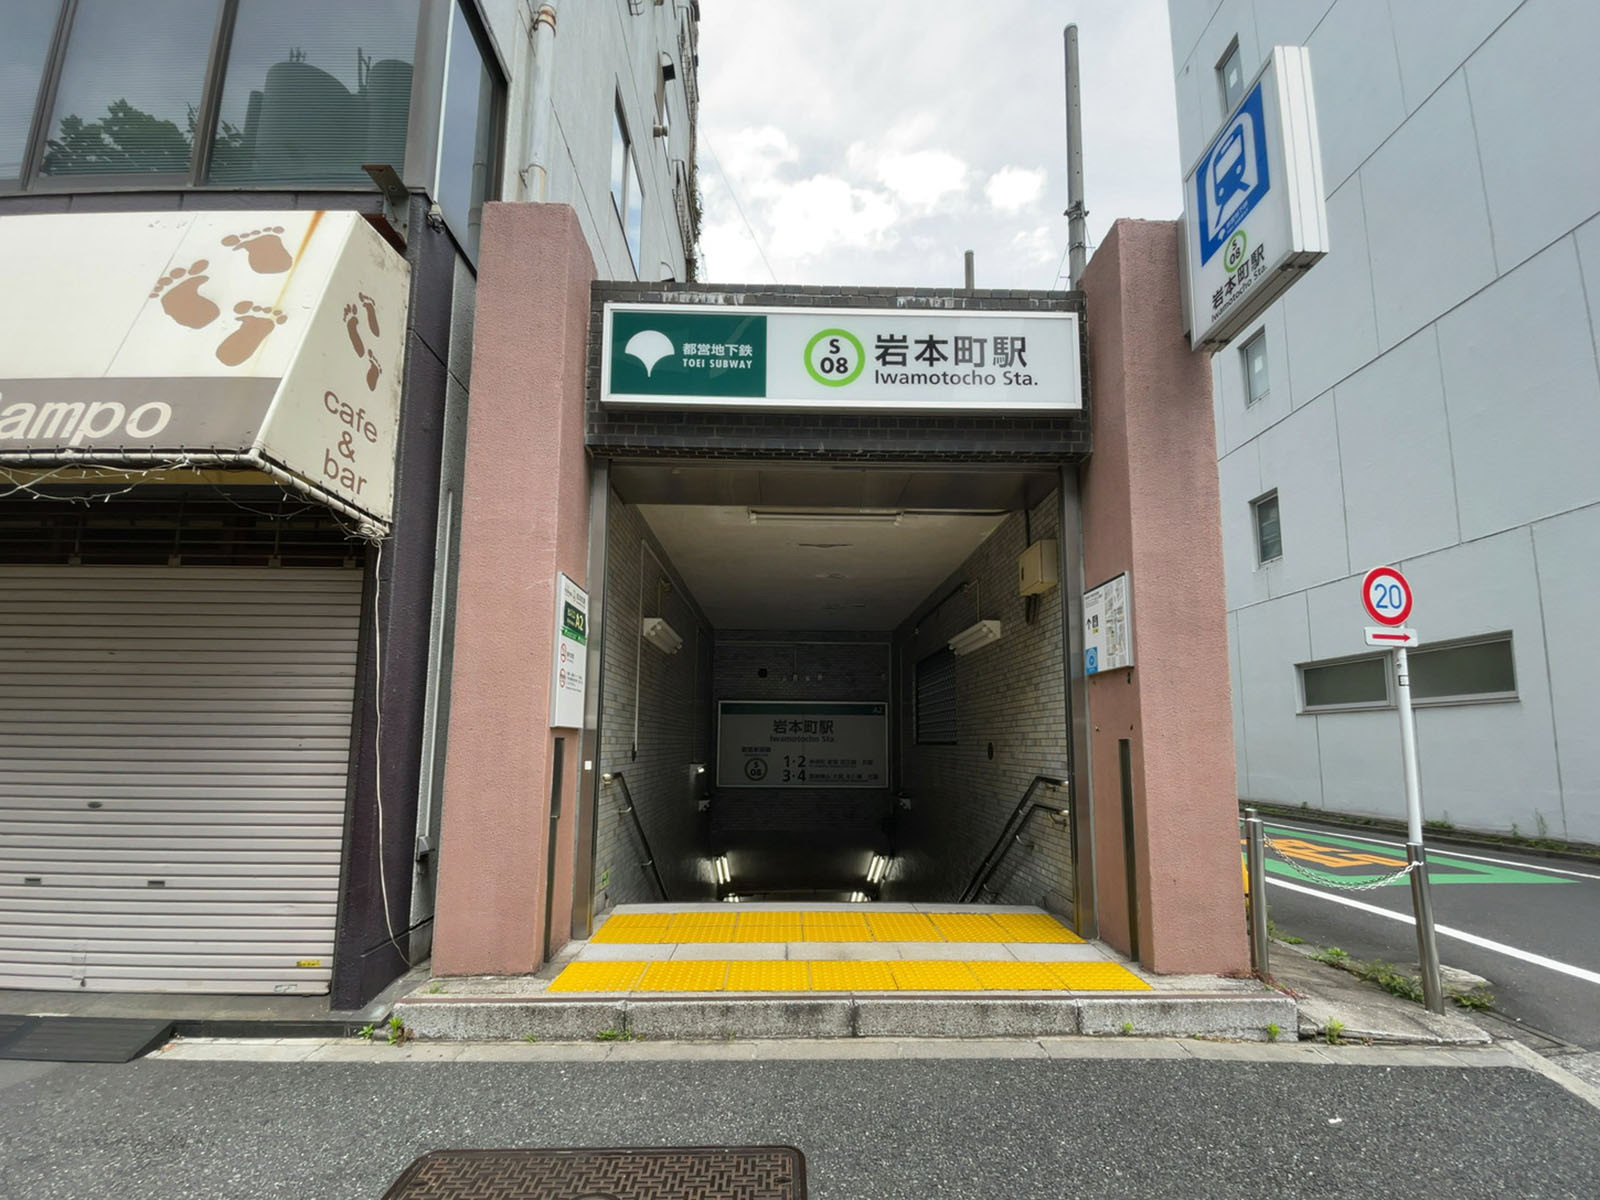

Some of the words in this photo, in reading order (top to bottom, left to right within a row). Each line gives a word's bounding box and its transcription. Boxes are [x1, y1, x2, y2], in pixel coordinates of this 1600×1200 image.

[1229, 247, 1241, 265] 08
[1212, 243, 1265, 309] 岩本町駅
[1211, 279, 1252, 322] Iwamotocho
[682, 343, 753, 357] 都営地下鉄
[829, 338, 841, 354] S
[875, 334, 1028, 368] 岩本町駅
[682, 358, 705, 368] TOEI
[709, 359, 753, 369] SUBWAY
[820, 357, 849, 374] 08
[875, 369, 996, 386] Iwamotocho
[1003, 371, 1039, 386] Sta.
[0, 392, 173, 446] ampo
[324, 390, 378, 443] cafe
[338, 431, 355, 463] &
[323, 448, 367, 494] bar
[1374, 583, 1402, 610] 20
[773, 719, 834, 735] 岩本町駅
